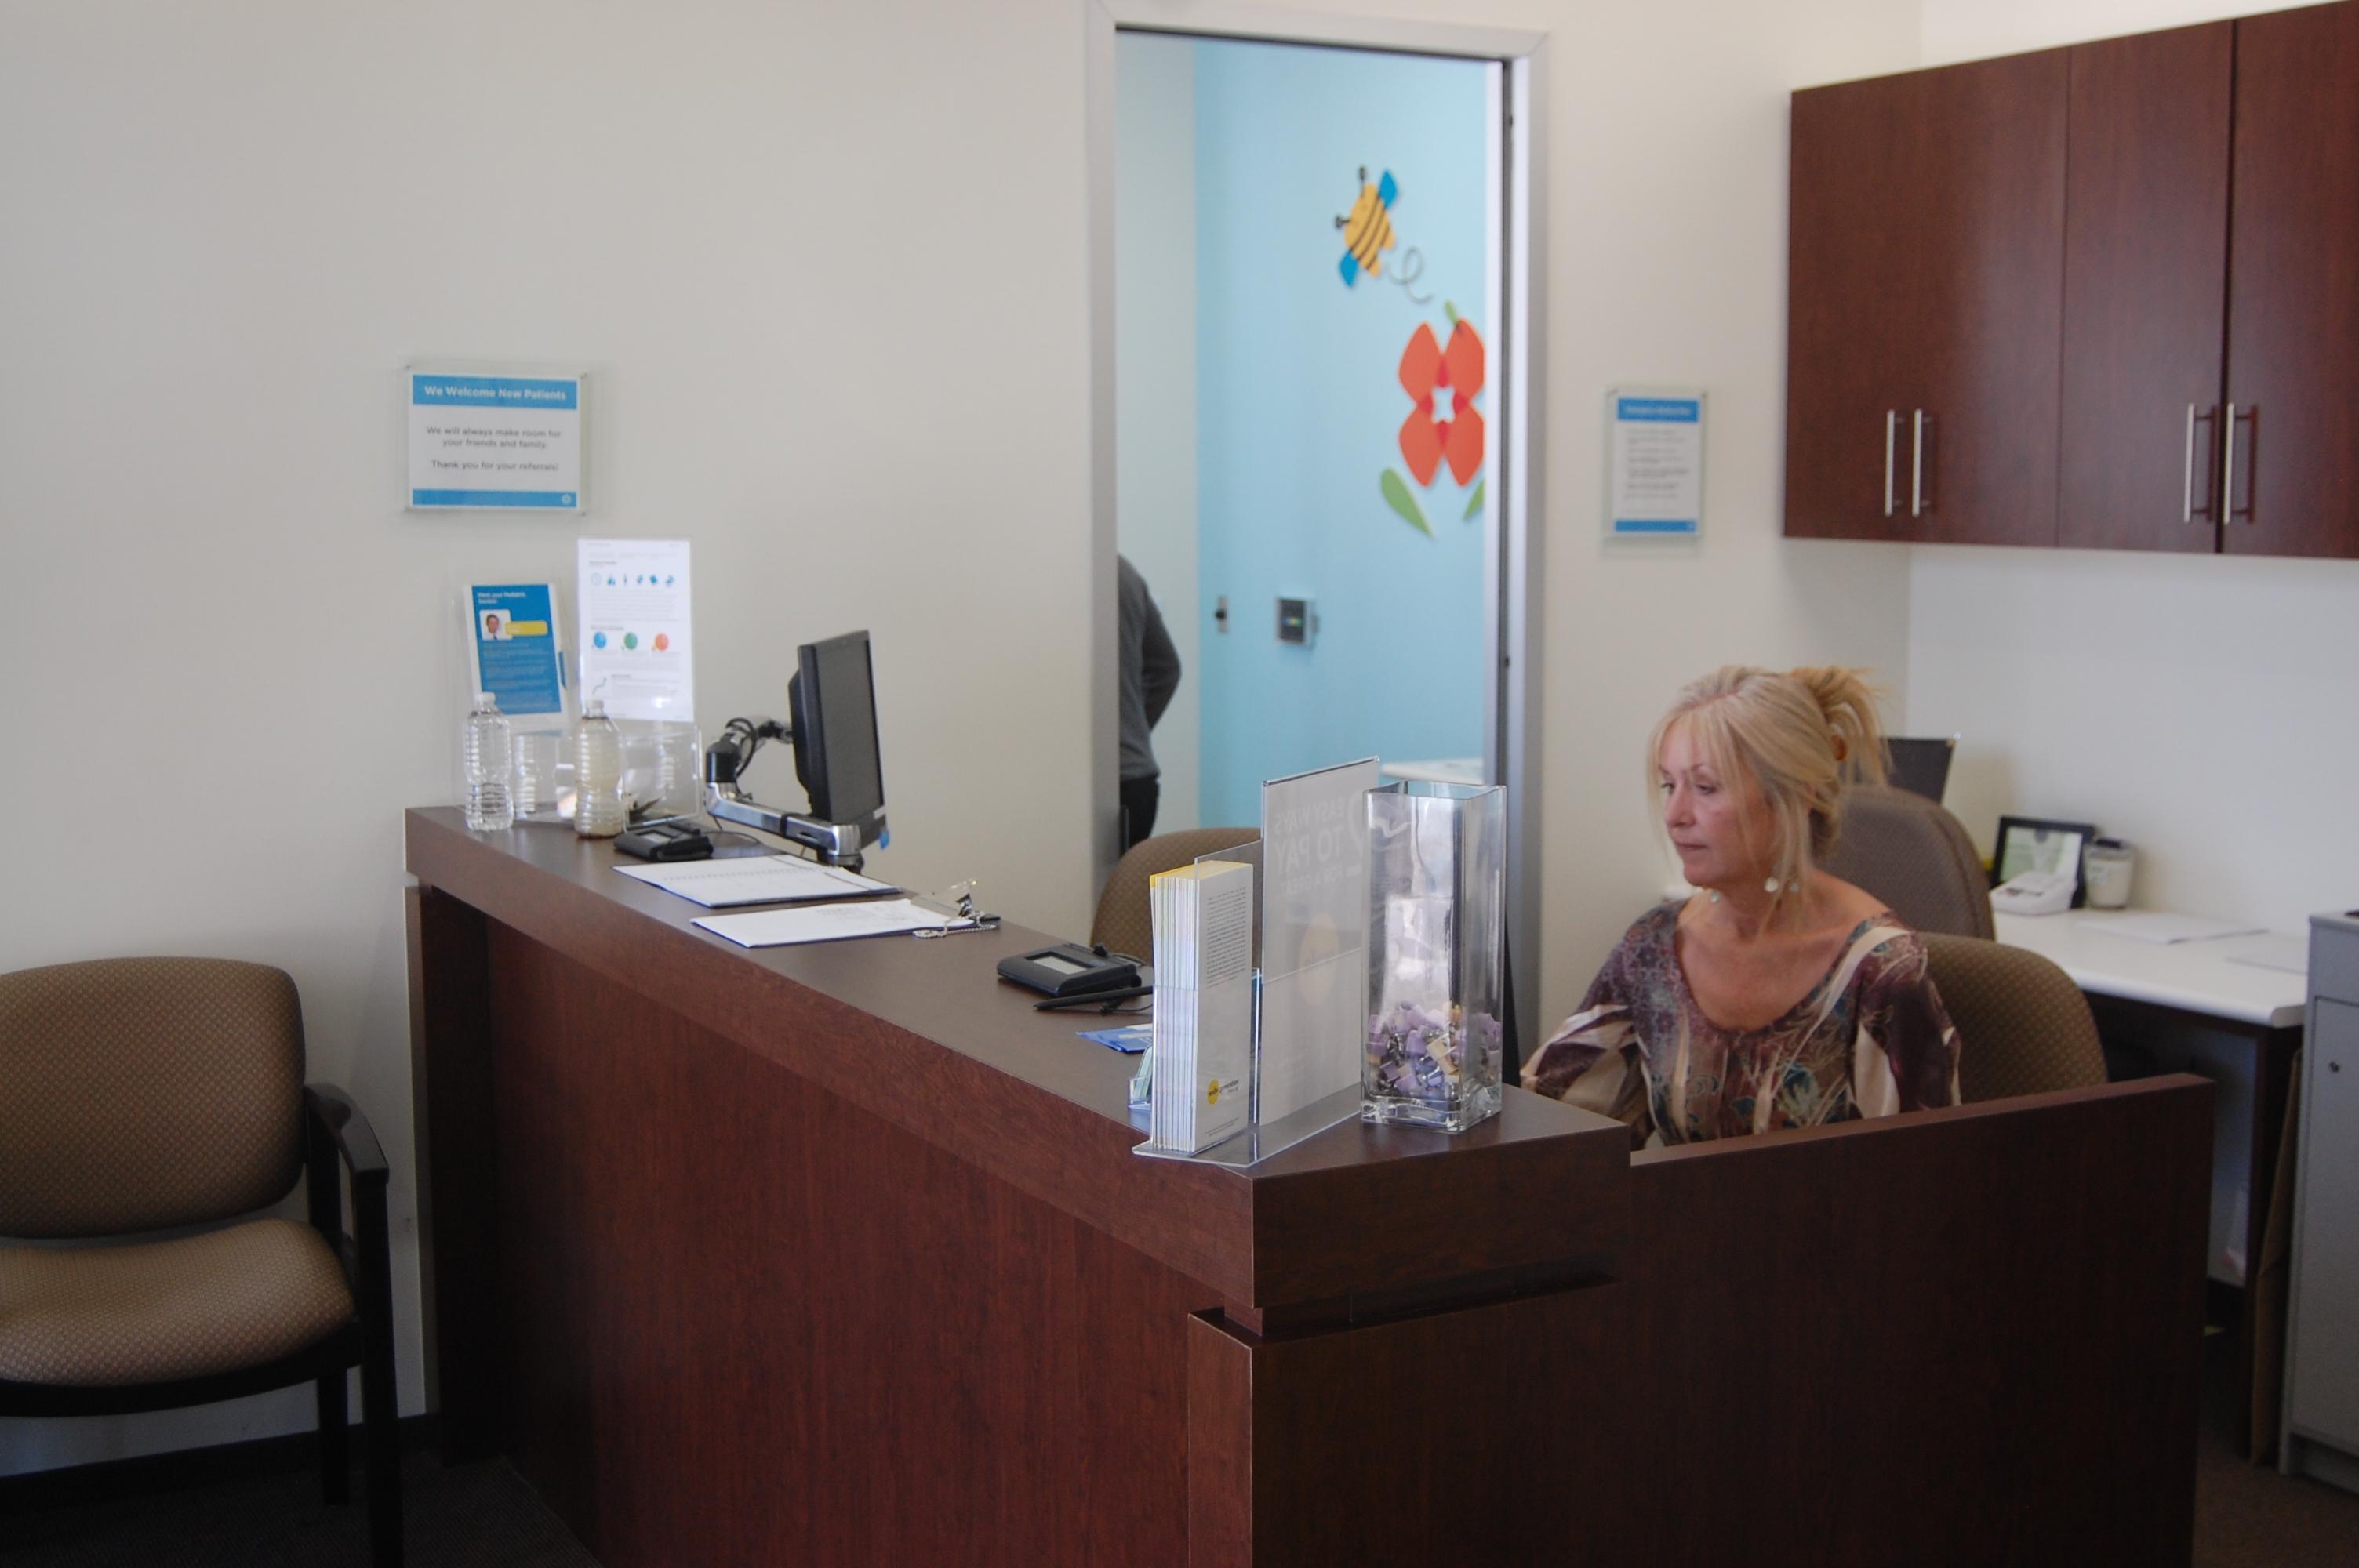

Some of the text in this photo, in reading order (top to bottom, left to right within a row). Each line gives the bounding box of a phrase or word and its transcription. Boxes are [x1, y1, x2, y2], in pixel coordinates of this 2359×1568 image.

[424, 386, 567, 401] We Welcome New Patients
[463, 427, 493, 437] always
[431, 460, 458, 469] Thank
[462, 462, 478, 470] you
[497, 463, 517, 471] your
